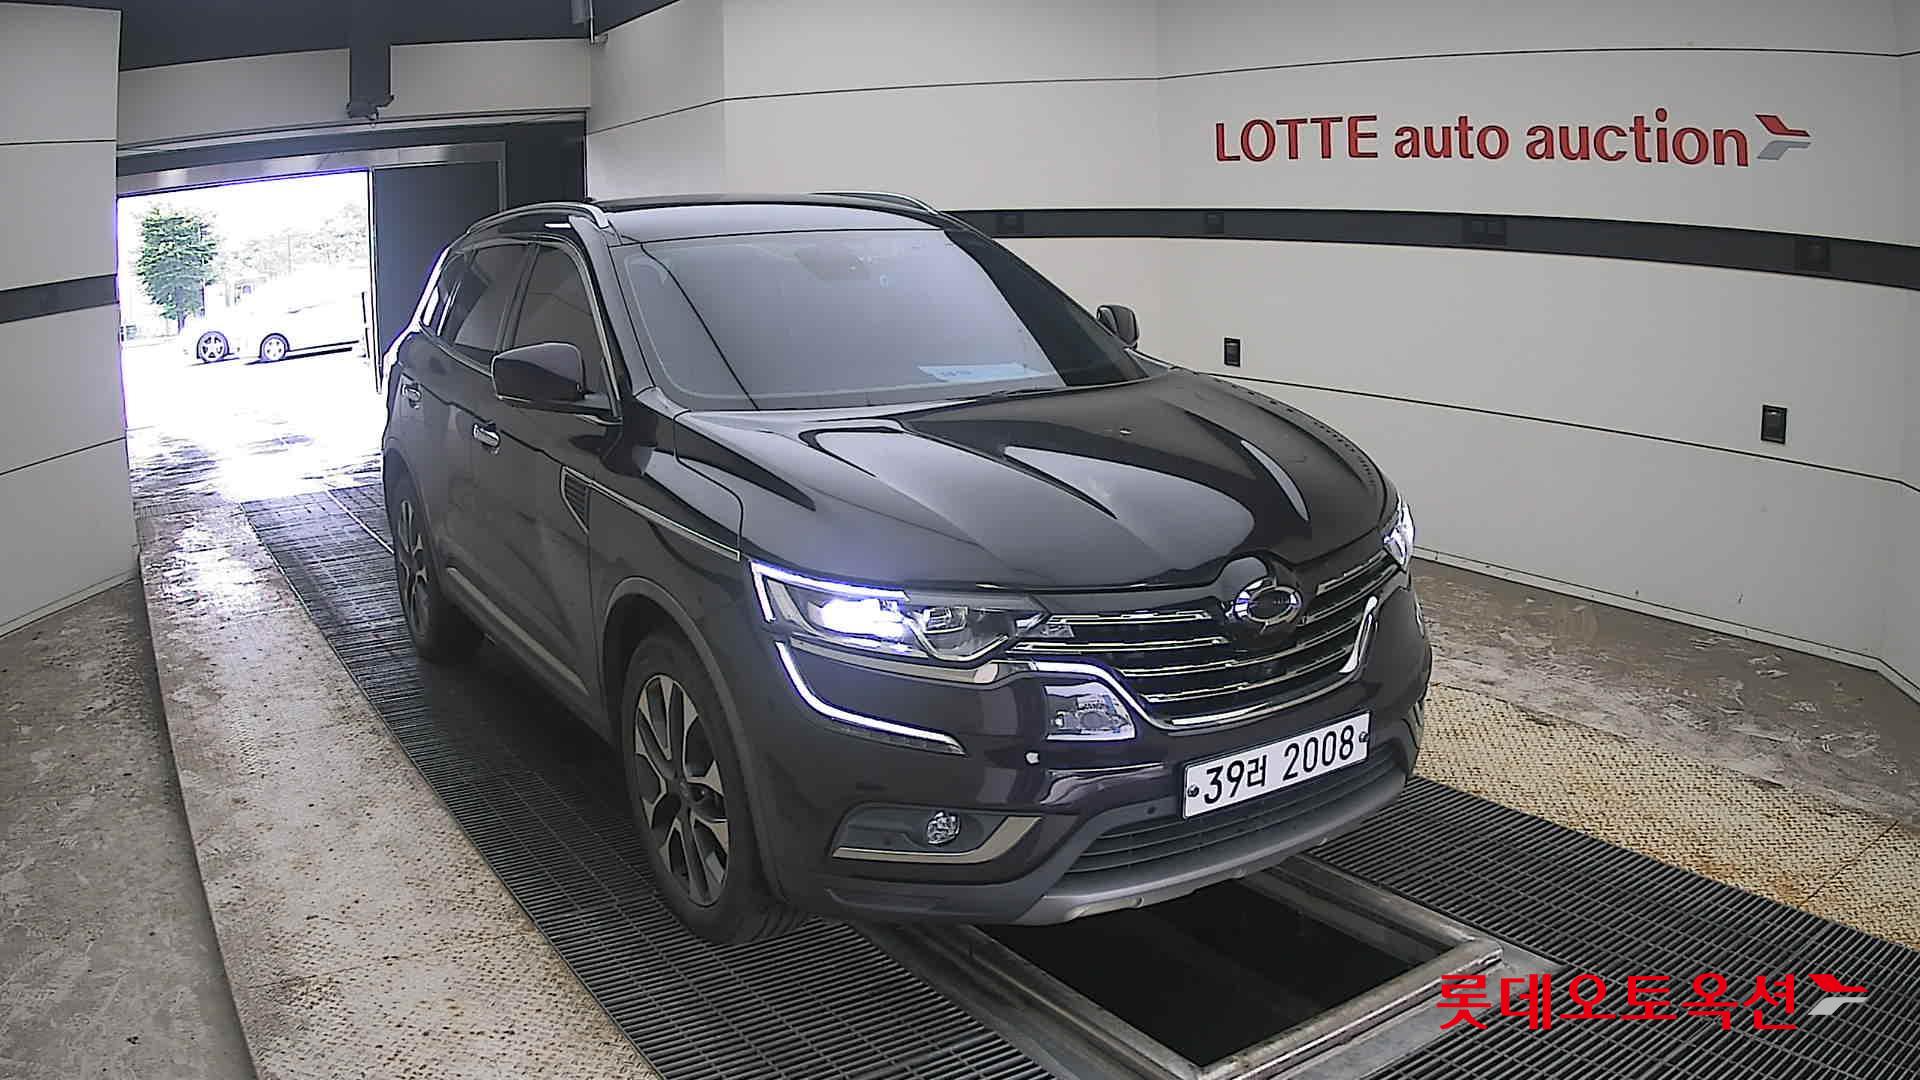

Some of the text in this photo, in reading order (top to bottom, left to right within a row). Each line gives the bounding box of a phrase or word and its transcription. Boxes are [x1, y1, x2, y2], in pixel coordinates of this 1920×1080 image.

[1215, 108, 1749, 167] LOTTE auto auction
[1203, 725, 1354, 804] 39러 2008
